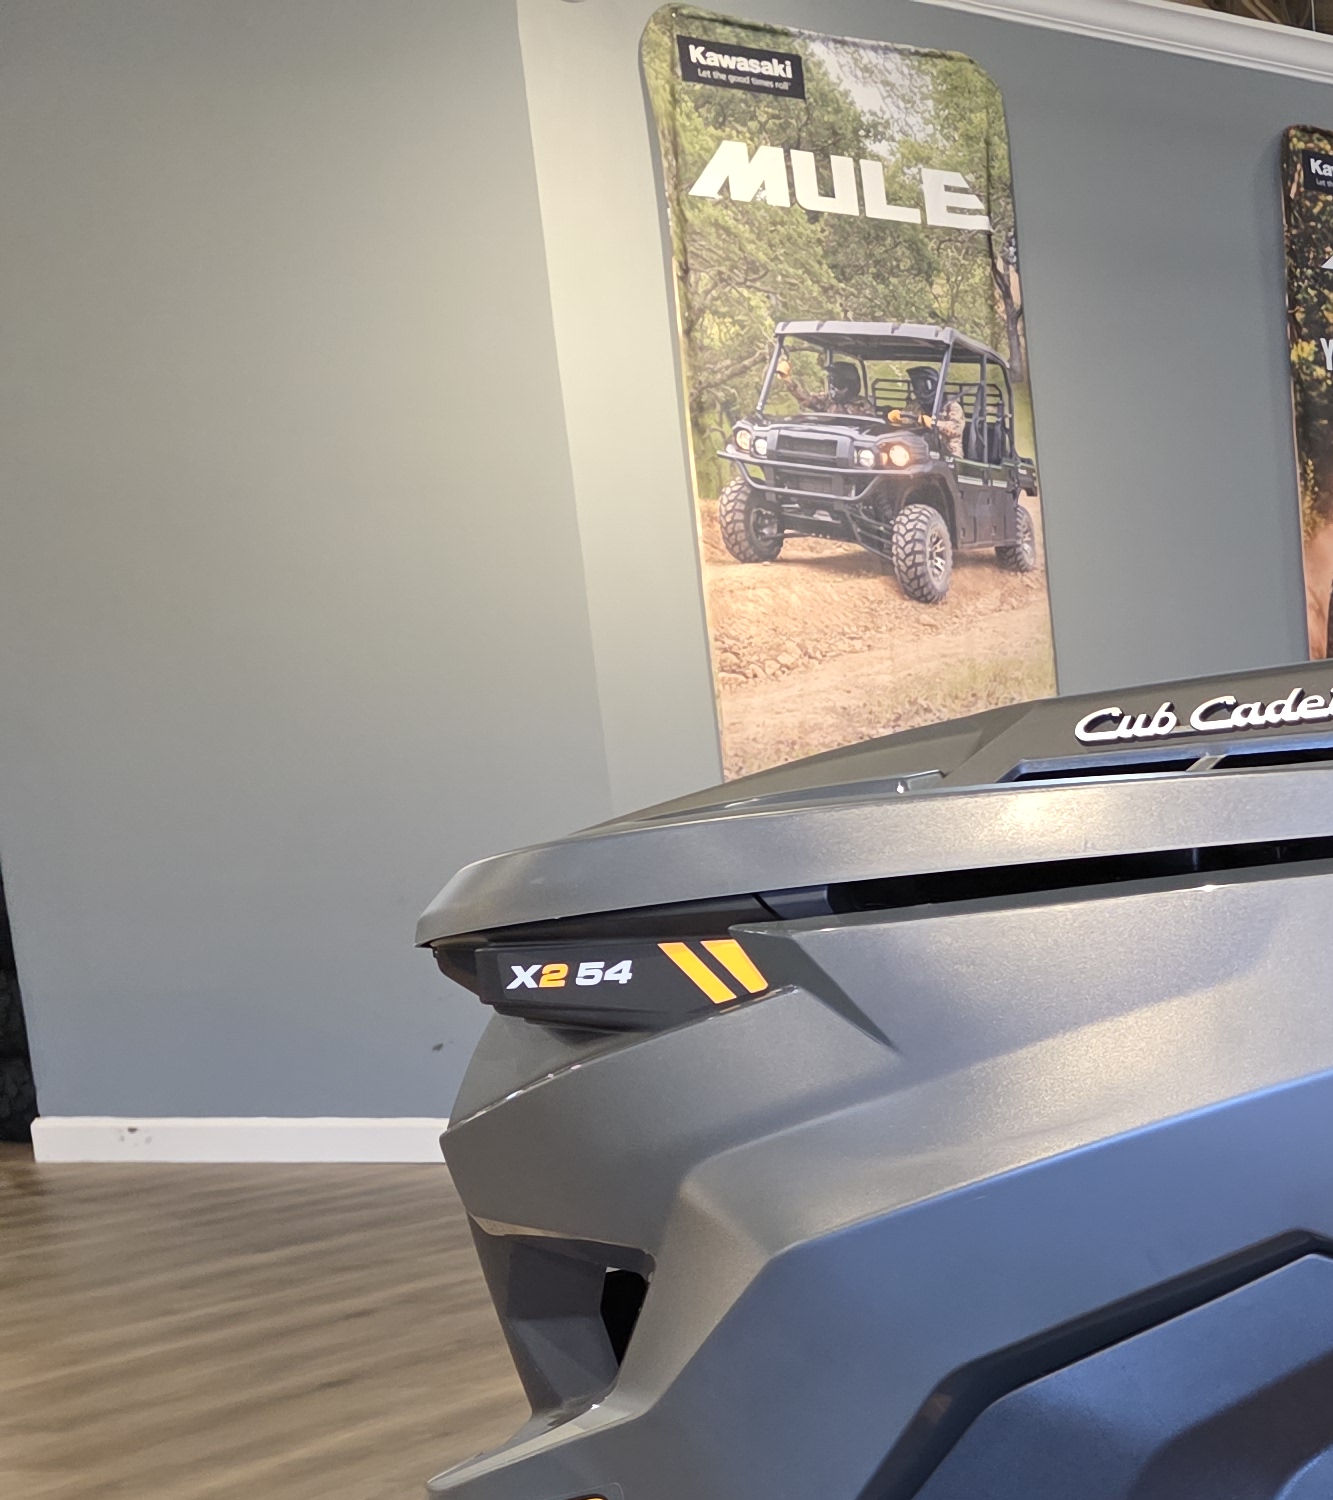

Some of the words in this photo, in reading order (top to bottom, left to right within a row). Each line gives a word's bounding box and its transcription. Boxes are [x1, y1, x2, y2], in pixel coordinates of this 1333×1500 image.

[688, 44, 793, 79] Kawasaki
[697, 67, 712, 79] Let
[712, 71, 727, 82] the
[689, 140, 992, 231] MULE
[1315, 177, 1326, 188] Let
[1075, 701, 1178, 744] Cub
[506, 963, 569, 990] X2
[575, 960, 633, 986] 54
